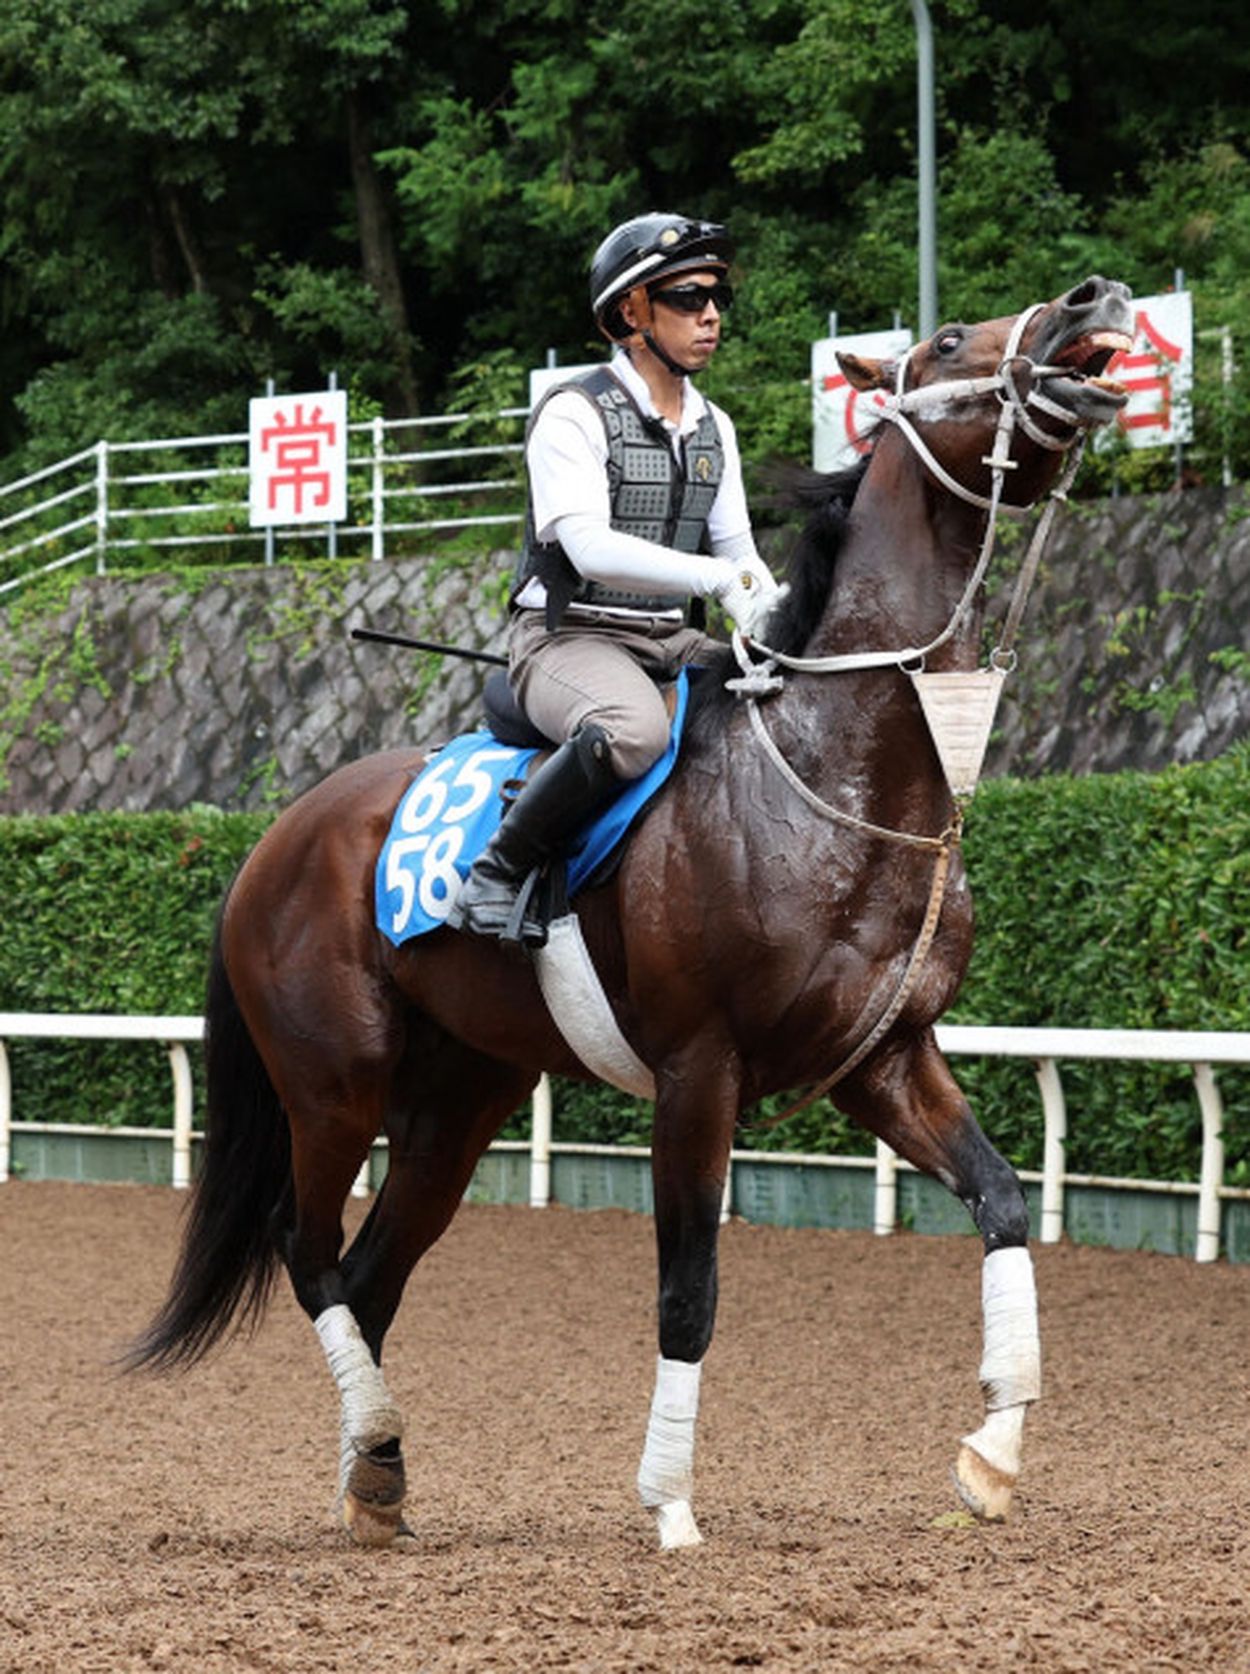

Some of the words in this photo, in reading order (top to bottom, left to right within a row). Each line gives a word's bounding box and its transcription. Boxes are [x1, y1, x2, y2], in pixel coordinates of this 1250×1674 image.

[261, 404, 336, 514] 常
[401, 750, 518, 833] 65
[386, 826, 464, 934] 58
